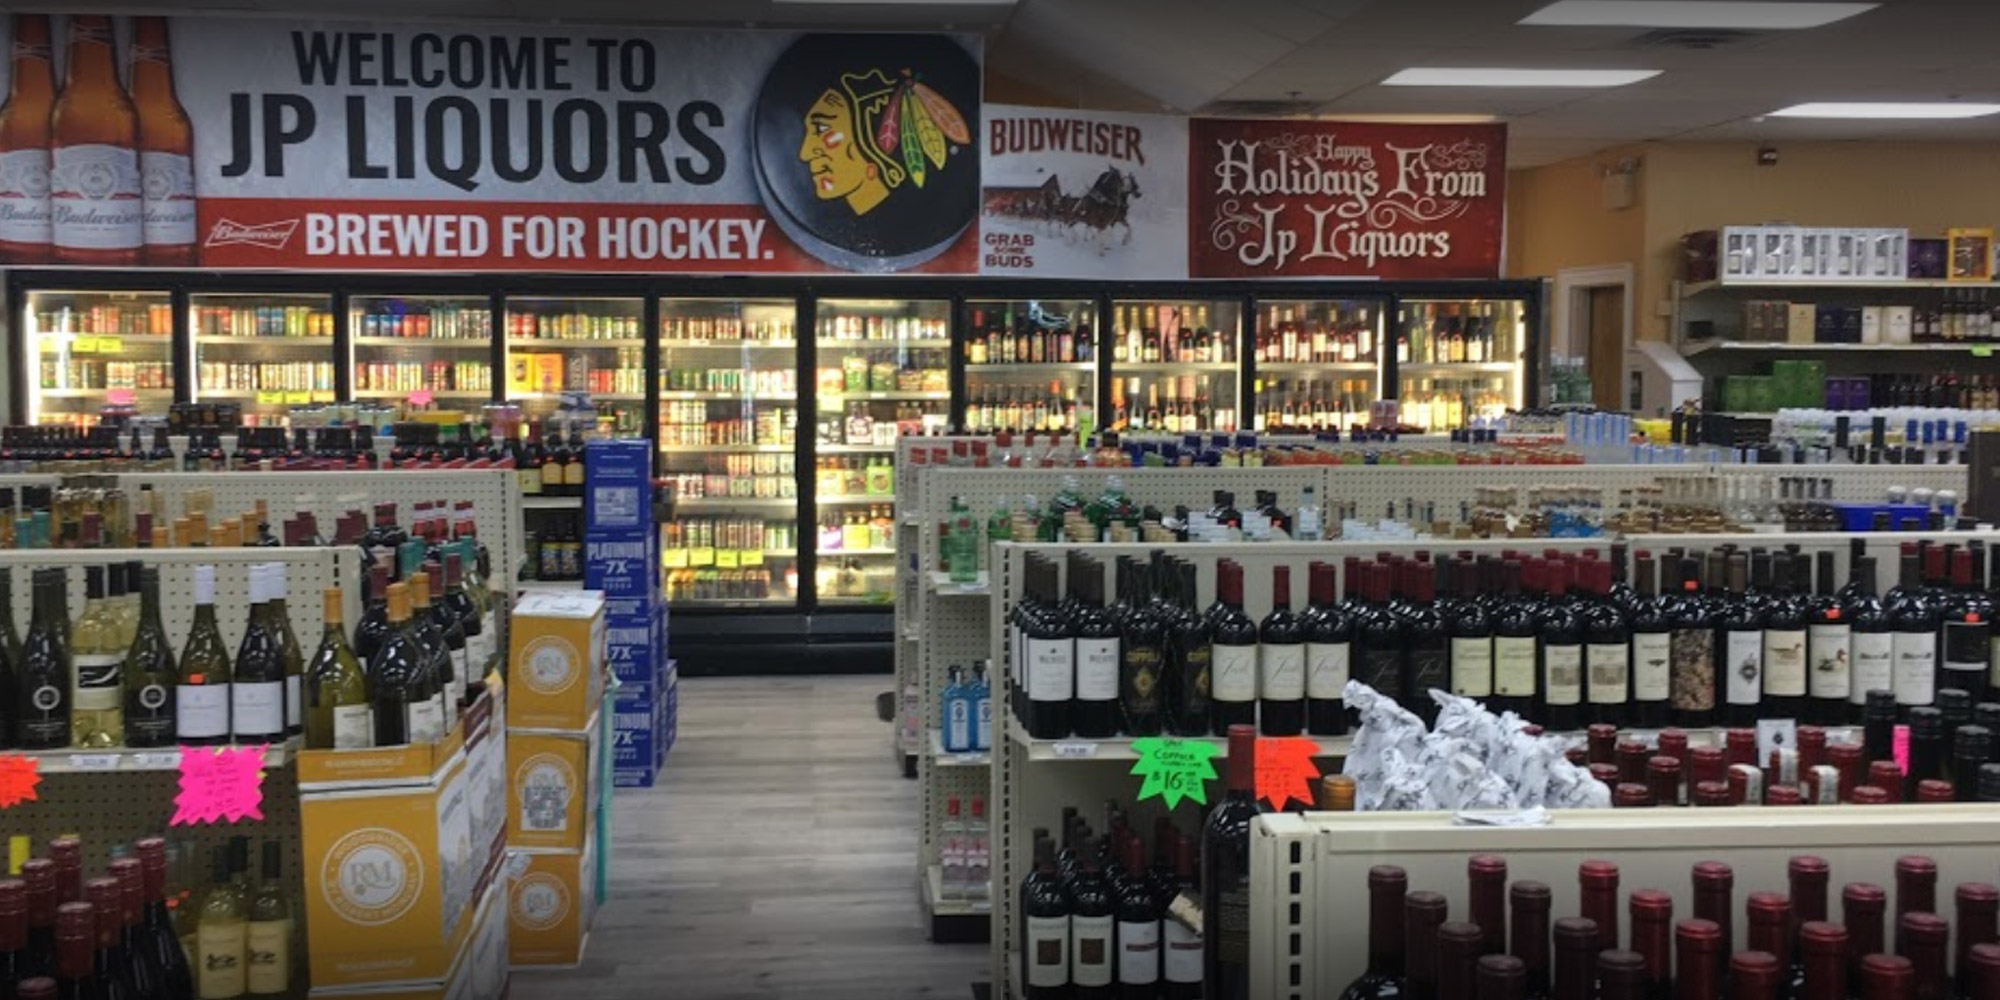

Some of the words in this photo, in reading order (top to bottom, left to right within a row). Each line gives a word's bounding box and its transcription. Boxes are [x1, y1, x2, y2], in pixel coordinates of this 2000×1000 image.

[292, 31, 574, 90] WELCOME
[589, 38, 656, 91] TO
[221, 93, 317, 178] JP
[346, 96, 725, 192] LIQUORS
[989, 117, 1144, 166] BUDWEISER
[1315, 134, 1375, 169] Happy
[1215, 139, 1379, 218] Holidays
[1385, 142, 1486, 200] From
[216, 225, 291, 241] Budweiser
[305, 214, 488, 257] BREWED
[502, 215, 586, 259] FOR
[598, 217, 774, 260] HOCKEY.
[985, 232, 1034, 247] GRAB
[1239, 203, 1297, 270] Jp
[1300, 203, 1450, 269] Liquors
[985, 254, 1034, 268] BUDS
[587, 541, 645, 561] PLATINUM
[605, 560, 629, 575] 7X
[610, 646, 632, 661] 7X
